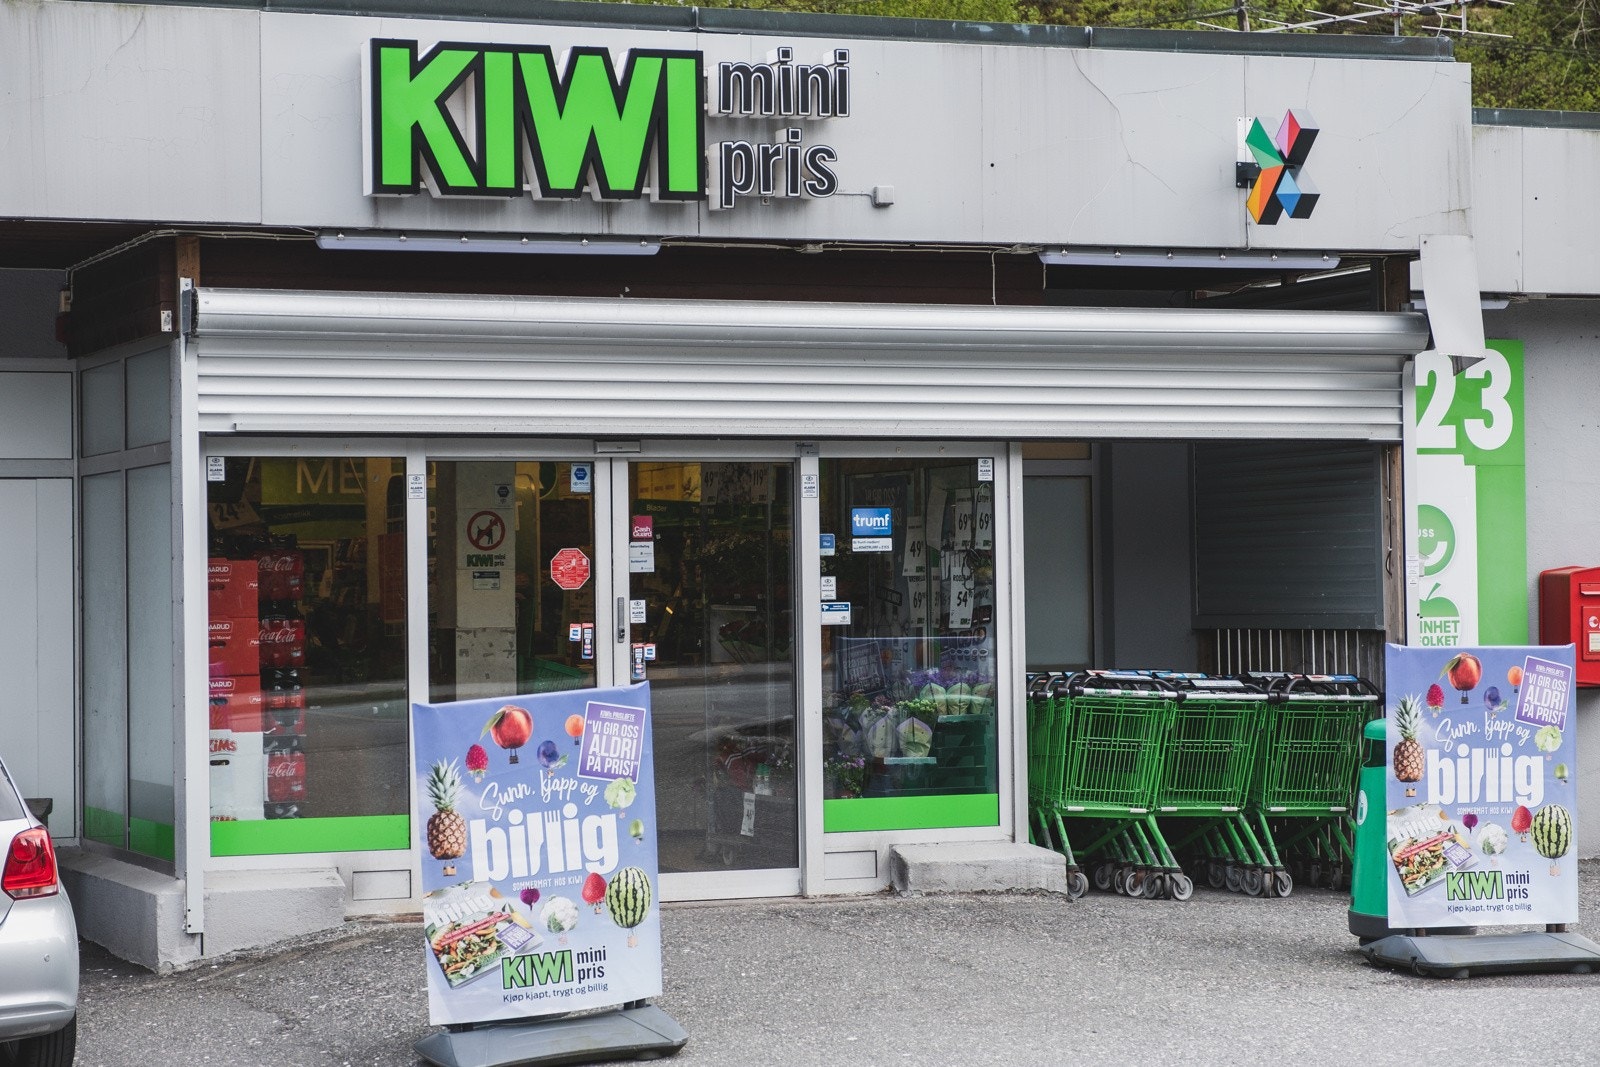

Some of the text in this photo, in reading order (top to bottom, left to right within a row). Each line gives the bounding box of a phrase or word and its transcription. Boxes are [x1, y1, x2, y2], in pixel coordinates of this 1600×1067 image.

[719, 47, 851, 118] mini
[370, 38, 704, 201] KIWI
[719, 128, 839, 210] pris
[1415, 348, 1514, 451] 23
[853, 513, 890, 527] trumf
[958, 513, 968, 531] 69
[979, 512, 989, 531] 69
[909, 540, 922, 558] 49
[1419, 636, 1459, 647] OLKET
[1538, 675, 1551, 688] GIR
[1552, 679, 1567, 692] OSS
[1525, 684, 1565, 711] ALDRI
[603, 721, 620, 736] GIR
[620, 724, 639, 739] OSS
[1484, 711, 1515, 741] kjapp
[1515, 725, 1531, 747] og
[588, 733, 638, 760] ALDRI
[1426, 742, 1545, 808] billig
[539, 769, 578, 804] kjapp
[580, 783, 599, 806] og
[1489, 807, 1500, 815] HOS
[1500, 806, 1514, 815] KIWI
[469, 802, 620, 883] billig
[512, 875, 583, 892] SOMMERMAT HOS KIWI
[1446, 870, 1505, 901] KIWI
[1505, 871, 1530, 885] mini
[1507, 886, 1529, 902] pris
[1447, 905, 1464, 913] Kjøp
[1465, 904, 1485, 913] kjapt,
[1486, 904, 1505, 912] trygt
[1514, 902, 1532, 911] billig
[576, 945, 607, 964] mini
[501, 949, 574, 989] KIWI
[577, 964, 605, 984] pris
[502, 982, 609, 1003] Kjøp kjapt, trygt og billig
